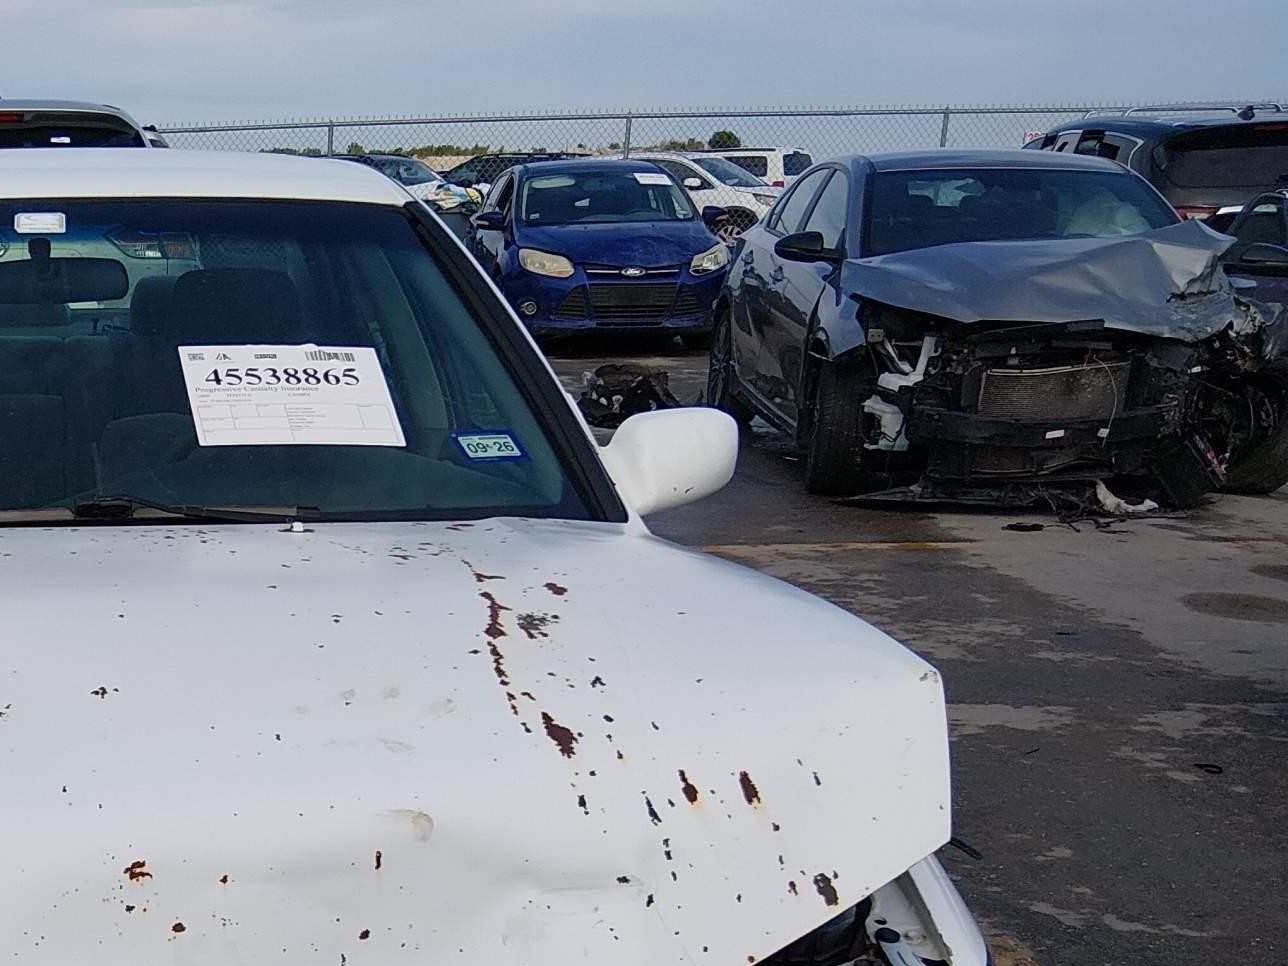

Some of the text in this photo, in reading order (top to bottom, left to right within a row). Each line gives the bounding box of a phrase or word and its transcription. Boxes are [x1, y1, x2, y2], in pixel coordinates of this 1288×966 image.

[205, 367, 360, 386] 45538865
[466, 441, 515, 453] 09 26
